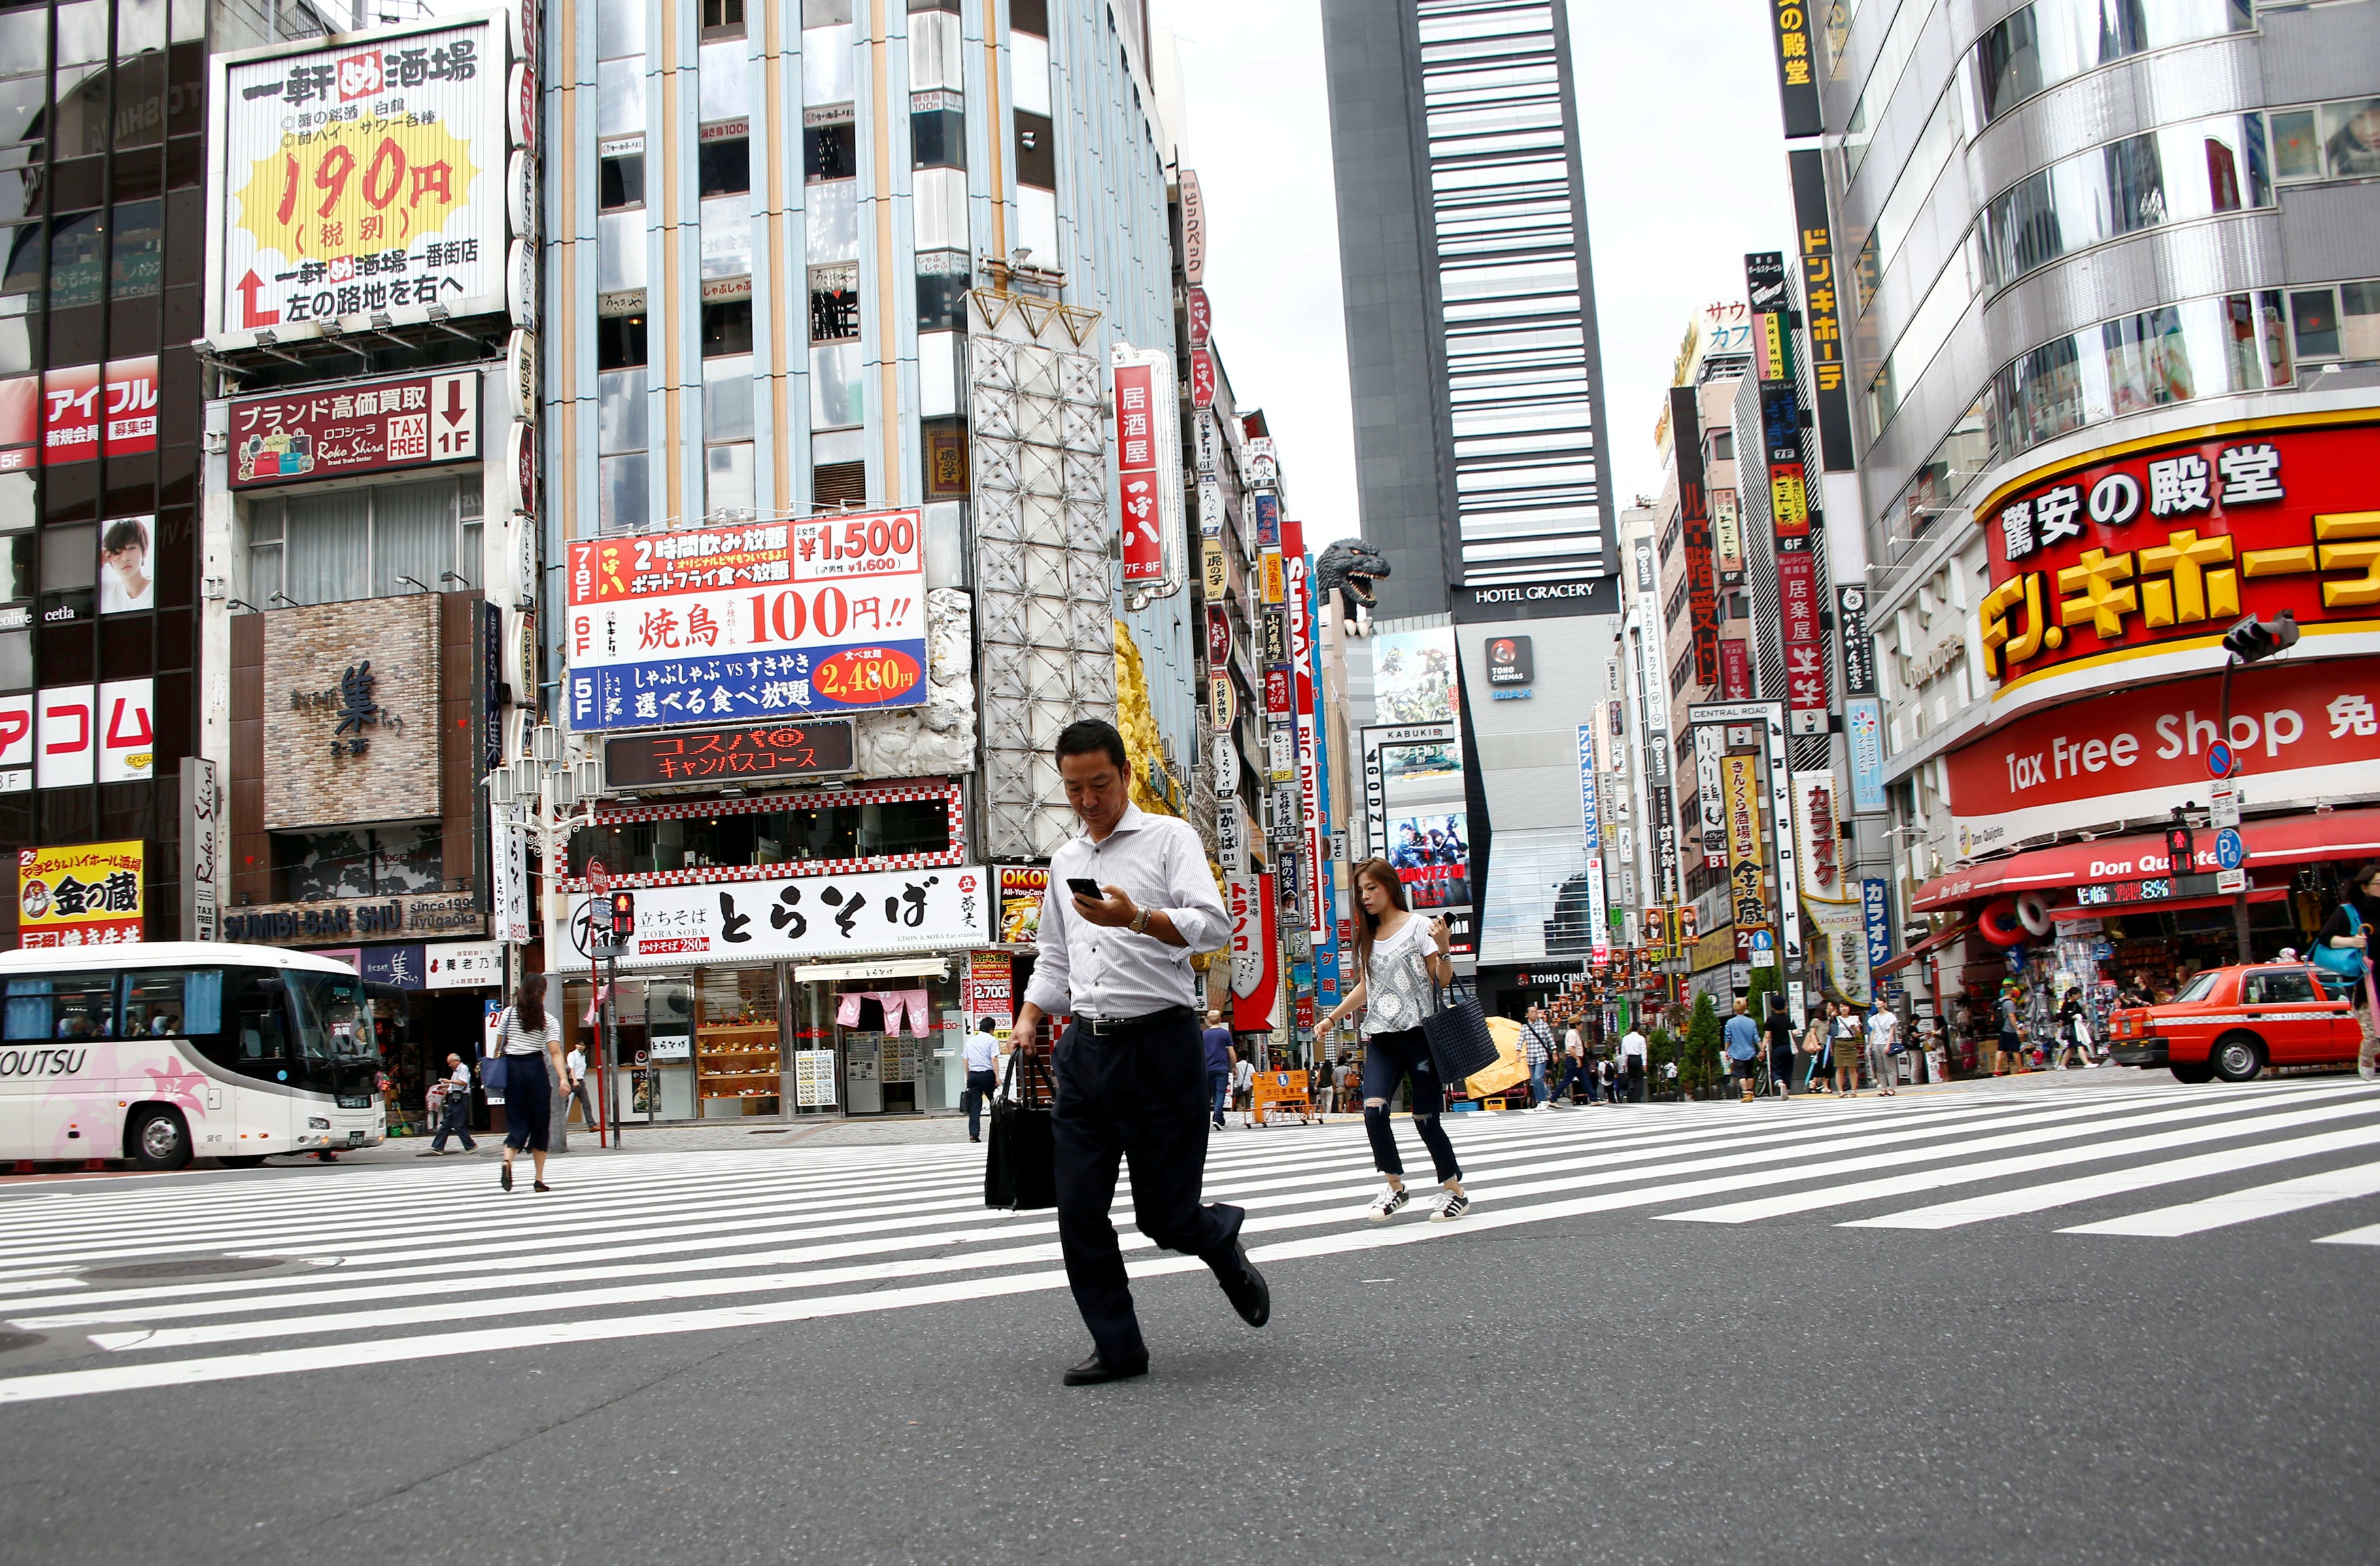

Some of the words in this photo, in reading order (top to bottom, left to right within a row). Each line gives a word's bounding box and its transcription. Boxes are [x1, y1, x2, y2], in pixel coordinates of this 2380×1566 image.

[276, 137, 454, 226] 190円
[286, 274, 464, 323] 左の路地を右へ
[1191, 301, 1209, 331] つぼ八
[1195, 363, 1213, 394] つぼ八
[46, 379, 158, 422] アイフル
[239, 386, 426, 431] ブランド高価買取
[46, 424, 99, 447] 新規会員
[114, 420, 152, 437] 募集中
[324, 423, 377, 441] ロコシーラ
[390, 418, 424, 438] TAX
[437, 430, 471, 454] 1F
[1122, 386, 1149, 464] 居酒屋
[318, 441, 347, 461] Roko
[352, 436, 384, 457] Shira
[390, 437, 424, 457] FREE
[940, 449, 957, 479] 虎の子
[1200, 460, 1213, 470] 6F
[1123, 480, 1159, 547] つぼ八
[2001, 444, 2285, 562] 驚安の殿堂
[633, 526, 788, 571] 2時間飲み放題
[799, 517, 914, 561] ¥1,500
[1784, 539, 1803, 549] 6F
[600, 547, 625, 595] つぼ八
[631, 559, 790, 594] ポテトフライ食べ放題
[1206, 556, 1223, 585] 虎の子
[1635, 545, 1652, 585] Booth
[1724, 572, 1739, 581] 6F
[1475, 588, 1525, 604] HOTEL
[1526, 582, 1595, 600] GRACERY
[638, 603, 719, 651] 焼鳥
[1287, 556, 1310, 679] SHIDAX
[1788, 580, 1813, 641] 居楽屋
[1265, 614, 1282, 654] 山内農場
[634, 660, 721, 688] しゃぶしゃぶ
[726, 662, 743, 678] VS
[747, 653, 810, 679] すきやき
[845, 649, 882, 661] 食べ放題
[1491, 666, 1515, 675] TOHO
[1647, 654, 1661, 687] カプセル
[821, 659, 913, 697] 2,480円
[1492, 673, 1524, 682] CINEMAS
[1788, 647, 1823, 707] 笑笑
[334, 660, 379, 736] 集
[575, 677, 592, 720] 5F
[634, 679, 813, 719] 選べる食べ放題
[1693, 709, 1739, 718] CENTRAL
[1741, 706, 1768, 715] ROAD
[0, 698, 154, 758] アコム
[658, 748, 817, 779] キャンパスコース
[1578, 730, 1591, 764] 747
[1651, 735, 1667, 777] Booth
[2006, 751, 2044, 794] Tax
[2052, 732, 2139, 780] Free
[2156, 707, 2304, 762] Shop
[1277, 771, 1289, 779] 3F
[195, 764, 213, 823] Shira
[1582, 766, 1596, 845] カラオケランド
[1731, 760, 1752, 839] きんくら酒場
[1221, 815, 1235, 851] かっぱ
[1658, 824, 1676, 869] 甘太郎
[1771, 758, 1797, 922] ゴジラロード
[1809, 785, 1837, 887] カラオケ
[1971, 834, 1983, 846] Don
[1983, 825, 2004, 842] Quijote
[20, 850, 37, 867] 2F
[196, 831, 214, 884] Roko
[1223, 853, 1235, 862] B1
[1709, 857, 1728, 868] B1
[2090, 860, 2132, 878] Don
[2219, 839, 2230, 865] P
[53, 871, 138, 917] 金の蔵
[960, 878, 975, 891] 立
[1248, 876, 1259, 917] 大衆酒場
[1412, 888, 1446, 900] 10.14
[1733, 859, 1767, 925] 金の蔵
[1939, 885, 1952, 900] Don
[1950, 880, 1971, 898] Quijote
[197, 905, 213, 915] TAX
[197, 915, 214, 925] FREE
[639, 907, 708, 928] 立ちそば
[718, 875, 940, 944] とらそば
[960, 896, 978, 929] 蕎麦
[1231, 883, 1249, 952] トラノコ
[1867, 883, 1888, 961] カラオケ
[639, 940, 679, 954] かけそば
[680, 938, 711, 951] 280円
[641, 929, 673, 939] TORA
[677, 927, 706, 937] SOBA
[897, 934, 919, 942] UDON
[957, 930, 984, 940] standing
[389, 950, 408, 985] 集
[972, 953, 1010, 963] お好み焼き
[1841, 932, 1860, 997] カラオケ
[974, 985, 1010, 1000] 2,700円
[1531, 973, 1560, 984] TOHO
[651, 1039, 687, 1051] とらそば
